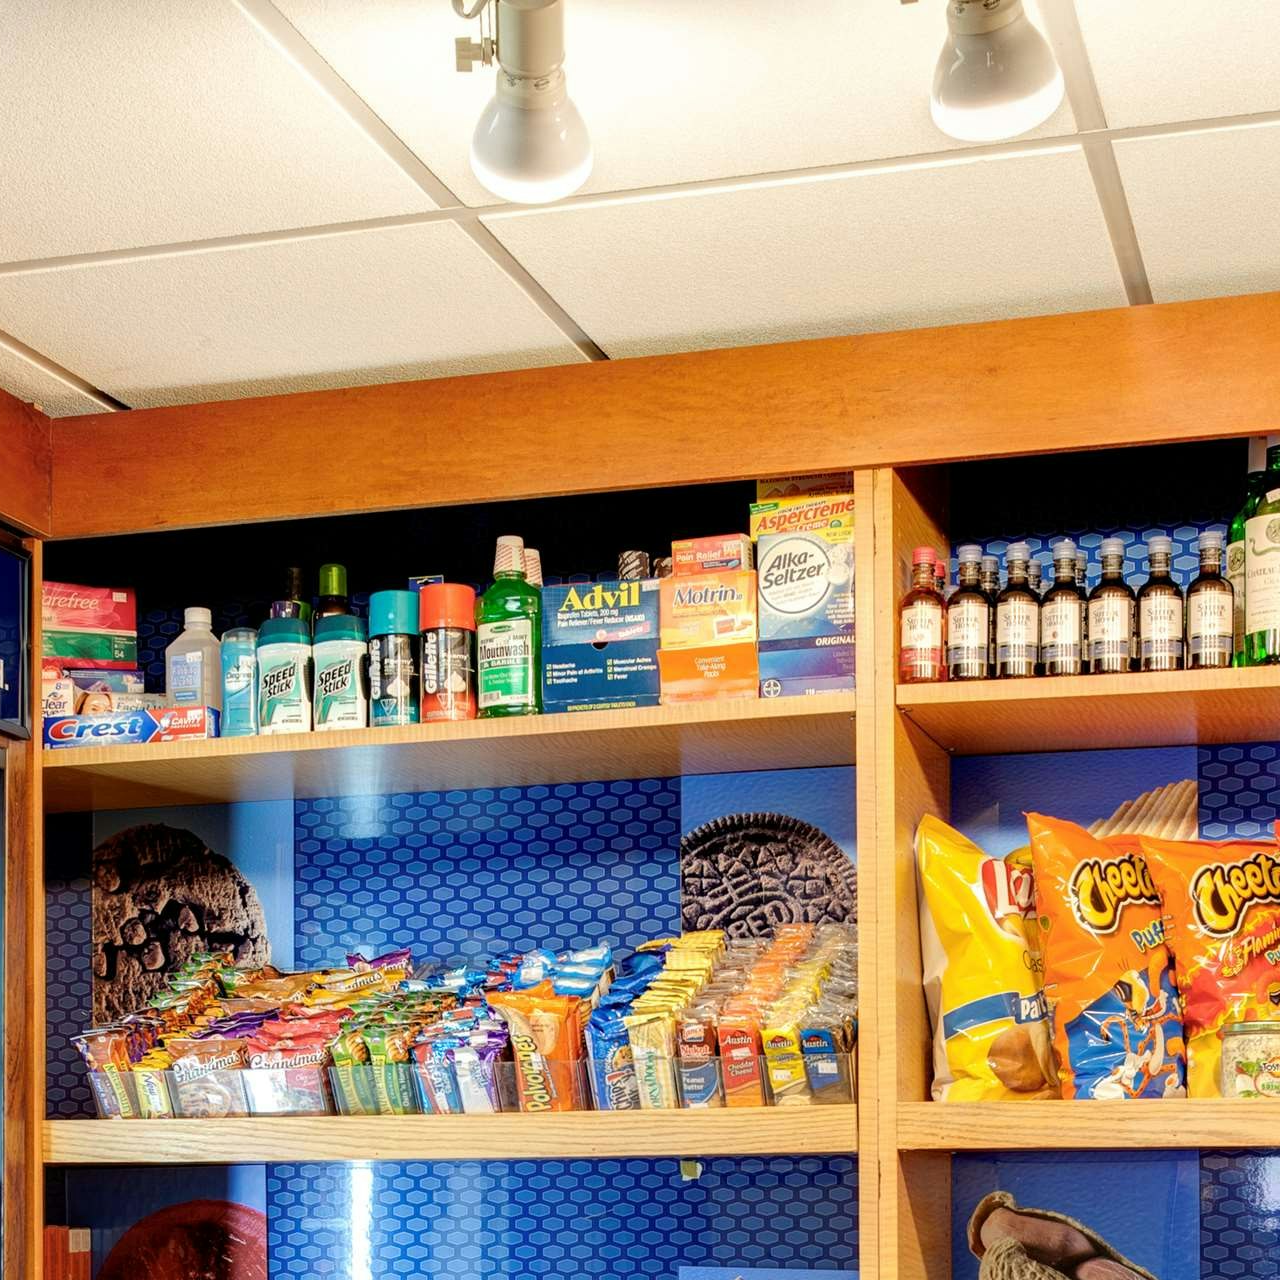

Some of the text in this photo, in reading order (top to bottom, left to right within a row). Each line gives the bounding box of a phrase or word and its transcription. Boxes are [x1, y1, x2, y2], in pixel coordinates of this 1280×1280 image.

[756, 498, 855, 533] Aspercreme
[676, 551, 721, 562] Pain Relief
[766, 551, 814, 573] Alka-
[763, 562, 825, 590] Seltzer
[561, 581, 641, 611] Advil
[673, 585, 736, 607] Motrin
[816, 636, 855, 646] ORIGINAL
[369, 638, 381, 700] Gillette
[424, 631, 437, 694] Gillette
[49, 717, 143, 741] Crest
[724, 1034, 752, 1045] Austin
[728, 1061, 754, 1071] Cheddar
[730, 1068, 753, 1077] Cheese
